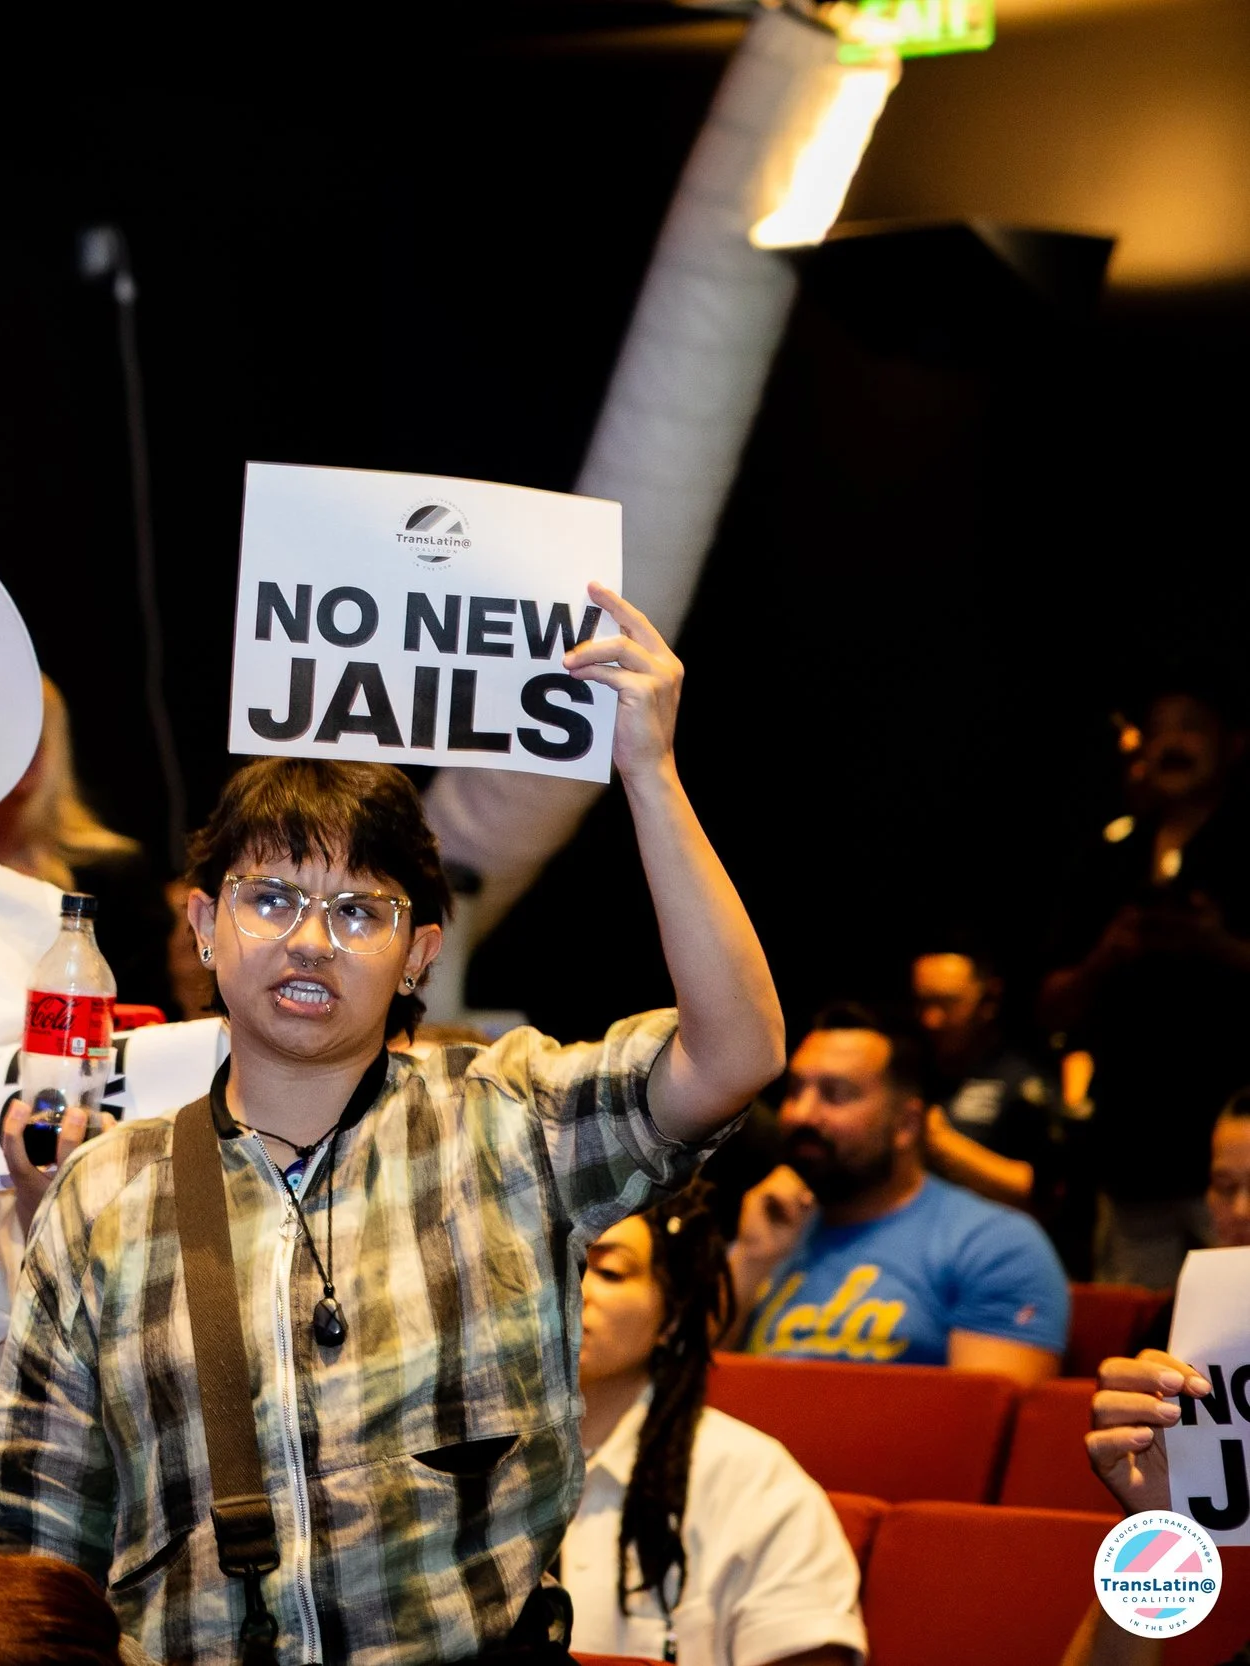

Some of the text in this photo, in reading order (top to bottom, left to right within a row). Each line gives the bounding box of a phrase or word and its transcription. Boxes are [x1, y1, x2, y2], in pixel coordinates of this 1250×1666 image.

[395, 533, 472, 549] TransLatin@
[254, 581, 602, 660] NO NEW
[247, 657, 595, 762] JAILS
